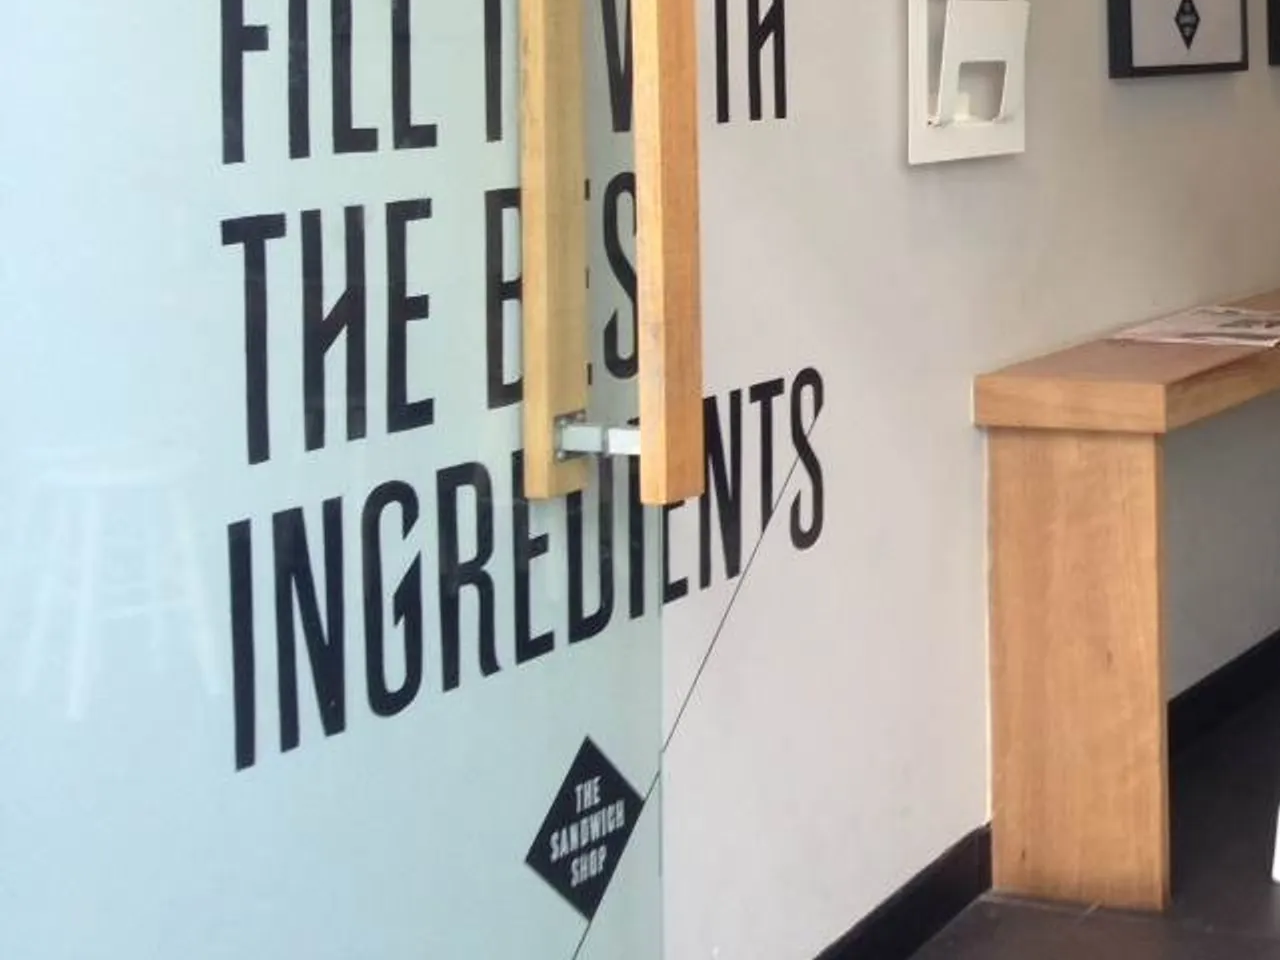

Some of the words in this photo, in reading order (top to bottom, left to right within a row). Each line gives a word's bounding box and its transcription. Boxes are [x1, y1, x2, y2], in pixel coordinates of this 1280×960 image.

[221, 197, 435, 466] THE
[485, 170, 639, 410] BS
[575, 775, 601, 814] THE
[549, 799, 626, 863] SANDWICH
[570, 844, 608, 888] SHOP
